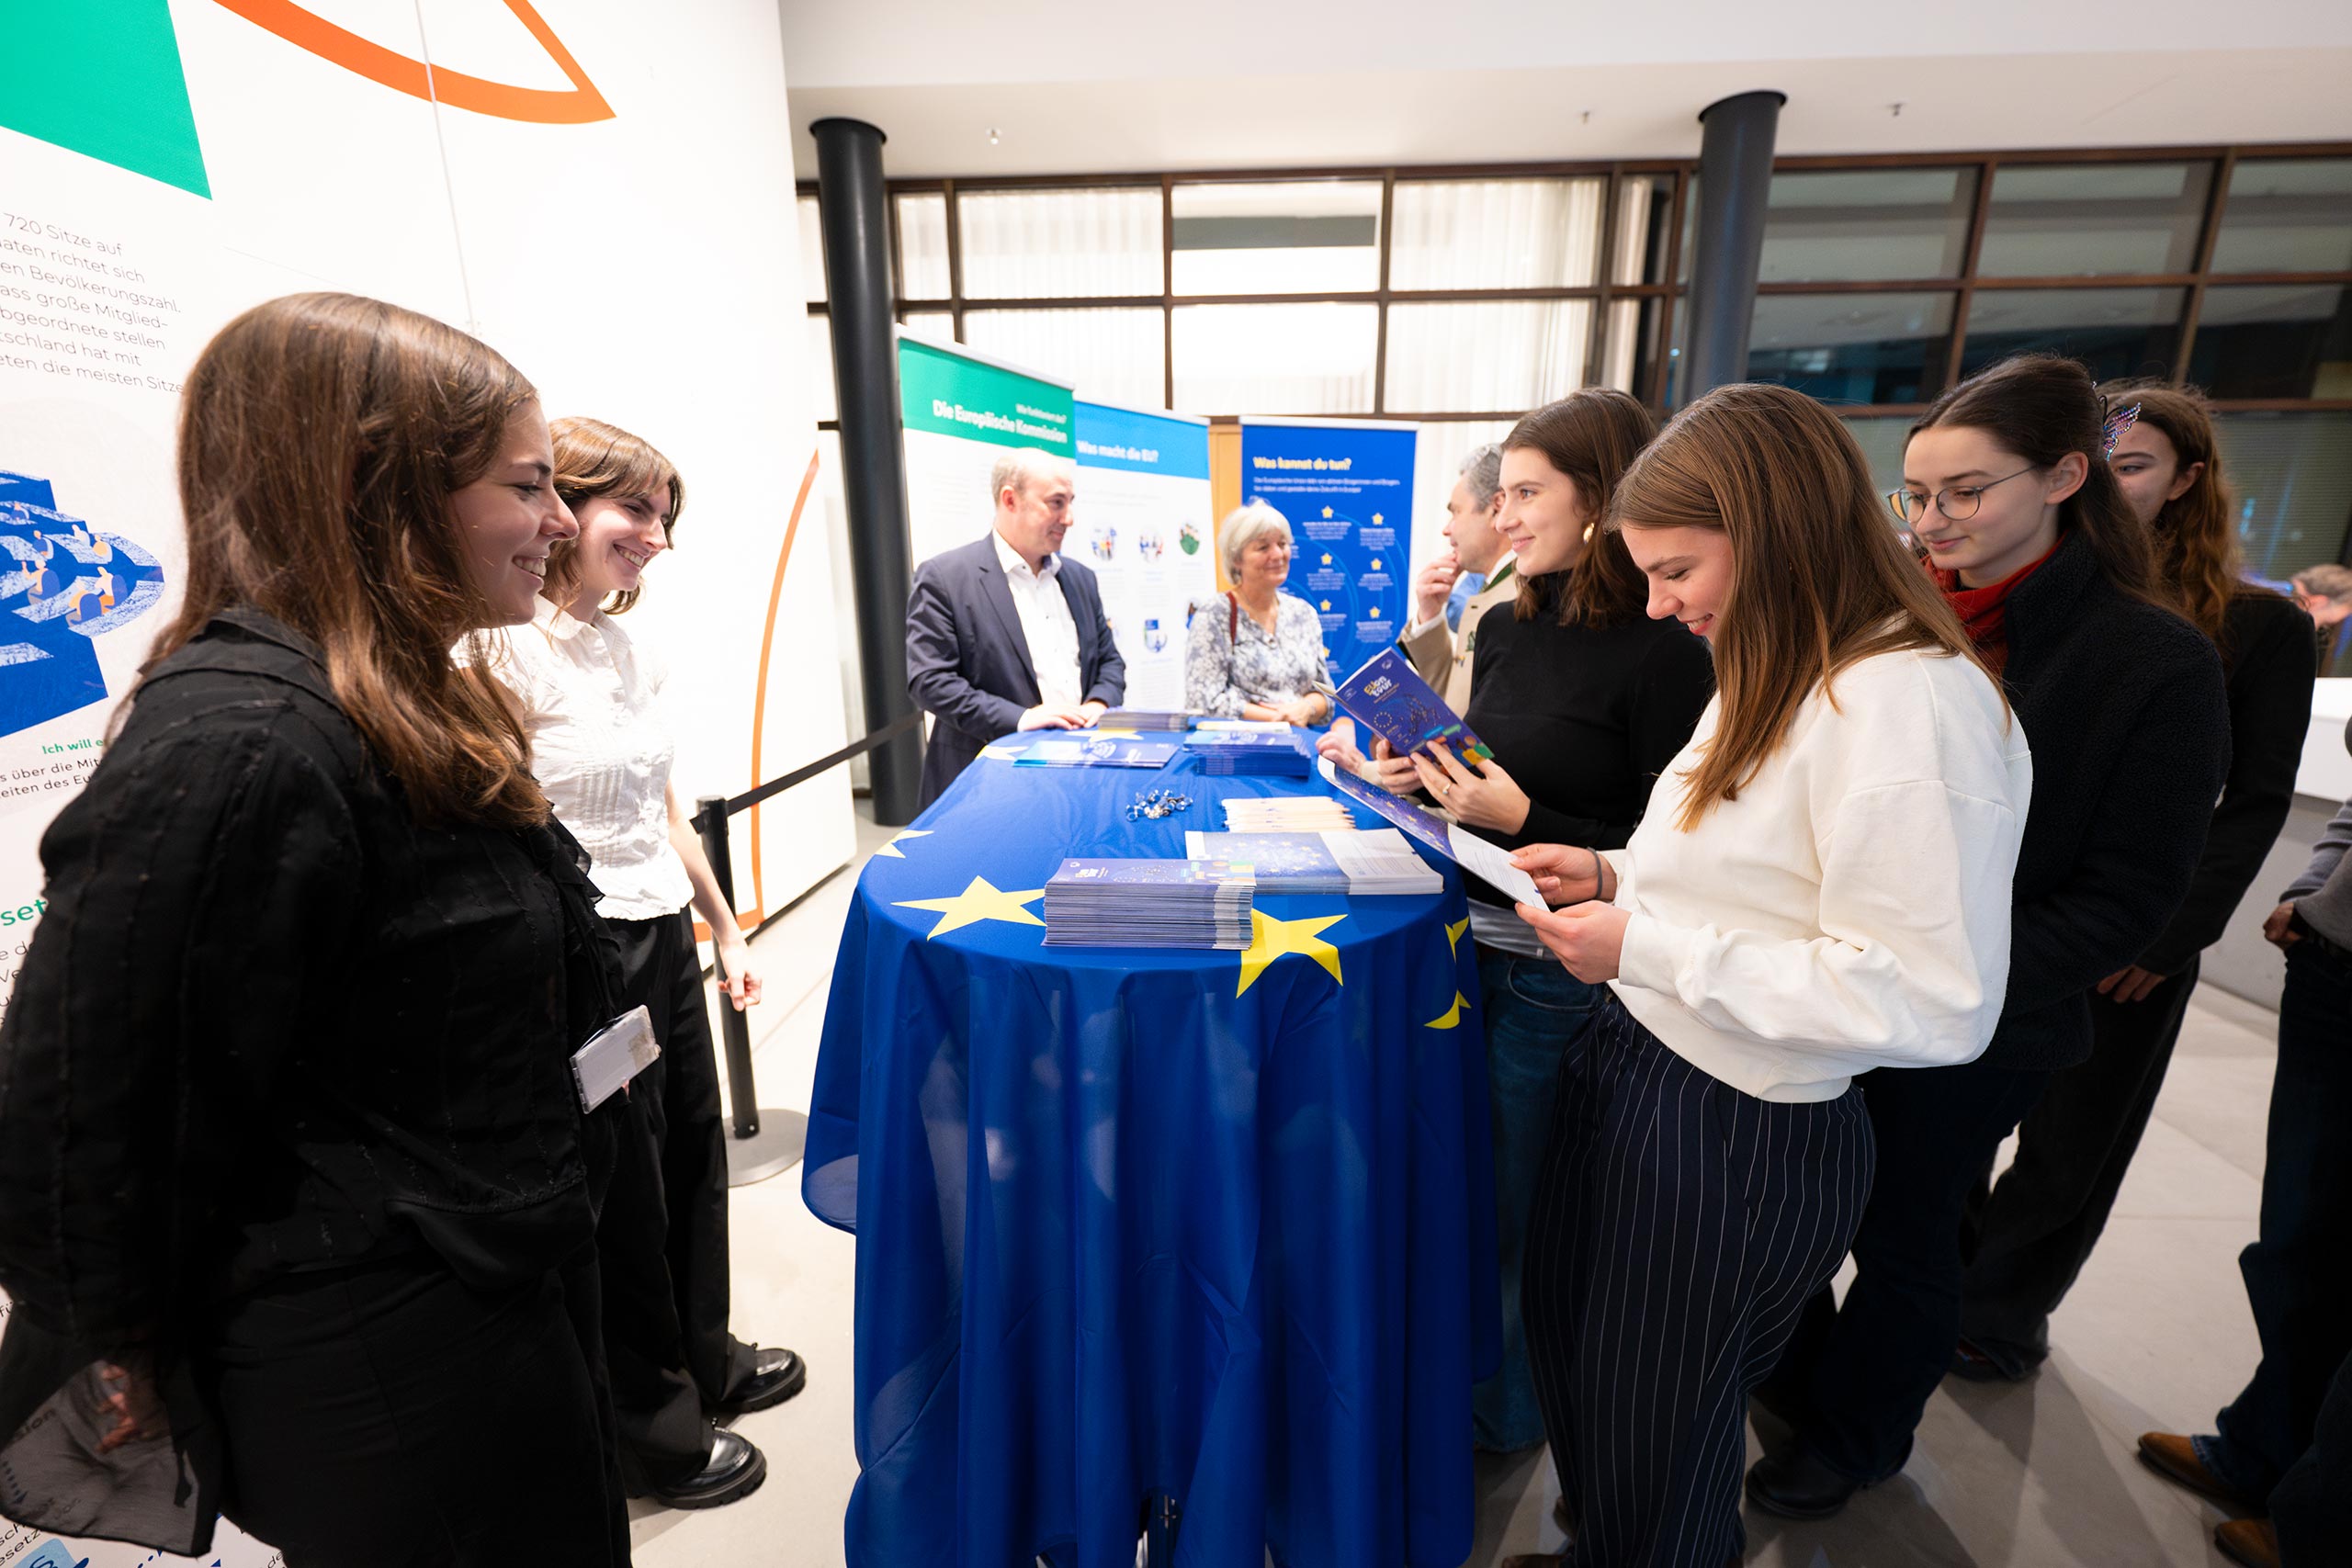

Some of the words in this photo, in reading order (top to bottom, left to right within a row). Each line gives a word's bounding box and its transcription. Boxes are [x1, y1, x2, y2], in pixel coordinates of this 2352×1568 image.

[4, 212, 42, 236] 720
[46, 224, 92, 248] Sitze
[96, 241, 123, 256] auf
[0, 238, 46, 258] aten
[51, 249, 109, 276] richtet
[112, 265, 145, 284] sich
[29, 265, 181, 313] Bevölkerungszahl.
[36, 292, 91, 314] große
[95, 302, 168, 329] Mitglied-
[113, 331, 166, 350] stellen
[82, 343, 110, 361] hat
[115, 351, 141, 367] mit
[42, 359, 71, 376] die
[76, 367, 143, 387] meisten
[146, 376, 185, 394] Sitze
[933, 399, 955, 420] Die
[954, 404, 1015, 433] Europäische
[1015, 419, 1068, 444] Kommission
[1076, 440, 1098, 456] Was
[1253, 457, 1277, 469] Was
[1313, 457, 1328, 470] du
[1329, 457, 1352, 470] tun?
[41, 742, 64, 754] Ich
[67, 739, 92, 750] will
[11, 768, 46, 781] über
[51, 762, 73, 773] die
[43, 779, 69, 790] des
